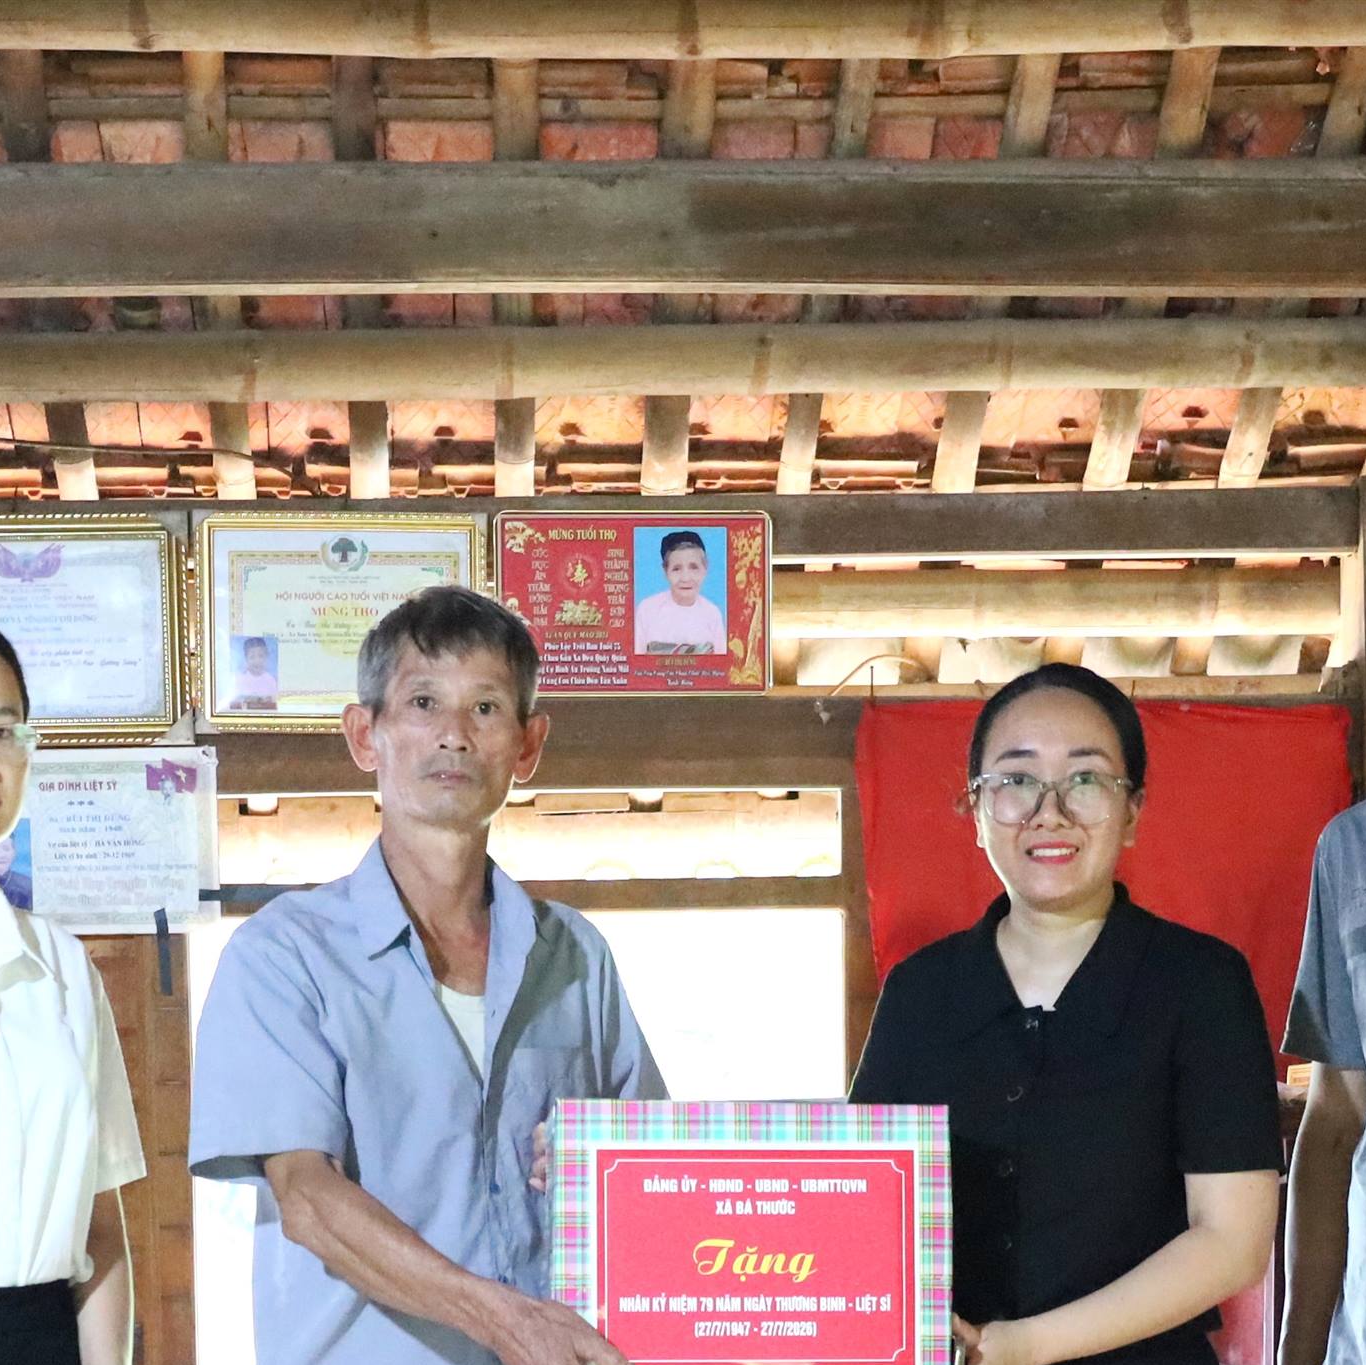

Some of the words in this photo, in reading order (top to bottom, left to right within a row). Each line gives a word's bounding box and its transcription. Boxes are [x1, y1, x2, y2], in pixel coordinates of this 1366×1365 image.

[576, 524, 596, 540] TUỔI
[327, 592, 348, 601] CAO
[372, 591, 389, 602] VIỆT
[38, 781, 55, 792] GIA
[84, 779, 104, 792] LIỆT
[643, 1175, 678, 1192] ĐẢNG
[681, 1174, 697, 1192] ỦY
[708, 1179, 744, 1192] HĐND
[755, 1179, 789, 1192] UBND
[801, 1179, 867, 1194] UBMTTQVN
[716, 1198, 733, 1215] XÃ
[736, 1198, 753, 1215] BÁ
[756, 1198, 796, 1215] THƯỚC
[693, 1239, 819, 1281] Tặng
[619, 1294, 650, 1312] NHÂN
[652, 1292, 667, 1312] KỶ
[669, 1294, 698, 1315] NIỆM
[715, 1294, 742, 1312] NĂM
[744, 1294, 773, 1312] NGÀY
[775, 1295, 818, 1312] THƯƠNG
[820, 1296, 846, 1312] BINH
[855, 1293, 877, 1315] LIỆT
[879, 1293, 891, 1312] SĨ
[695, 1321, 751, 1338] (27/7/1947
